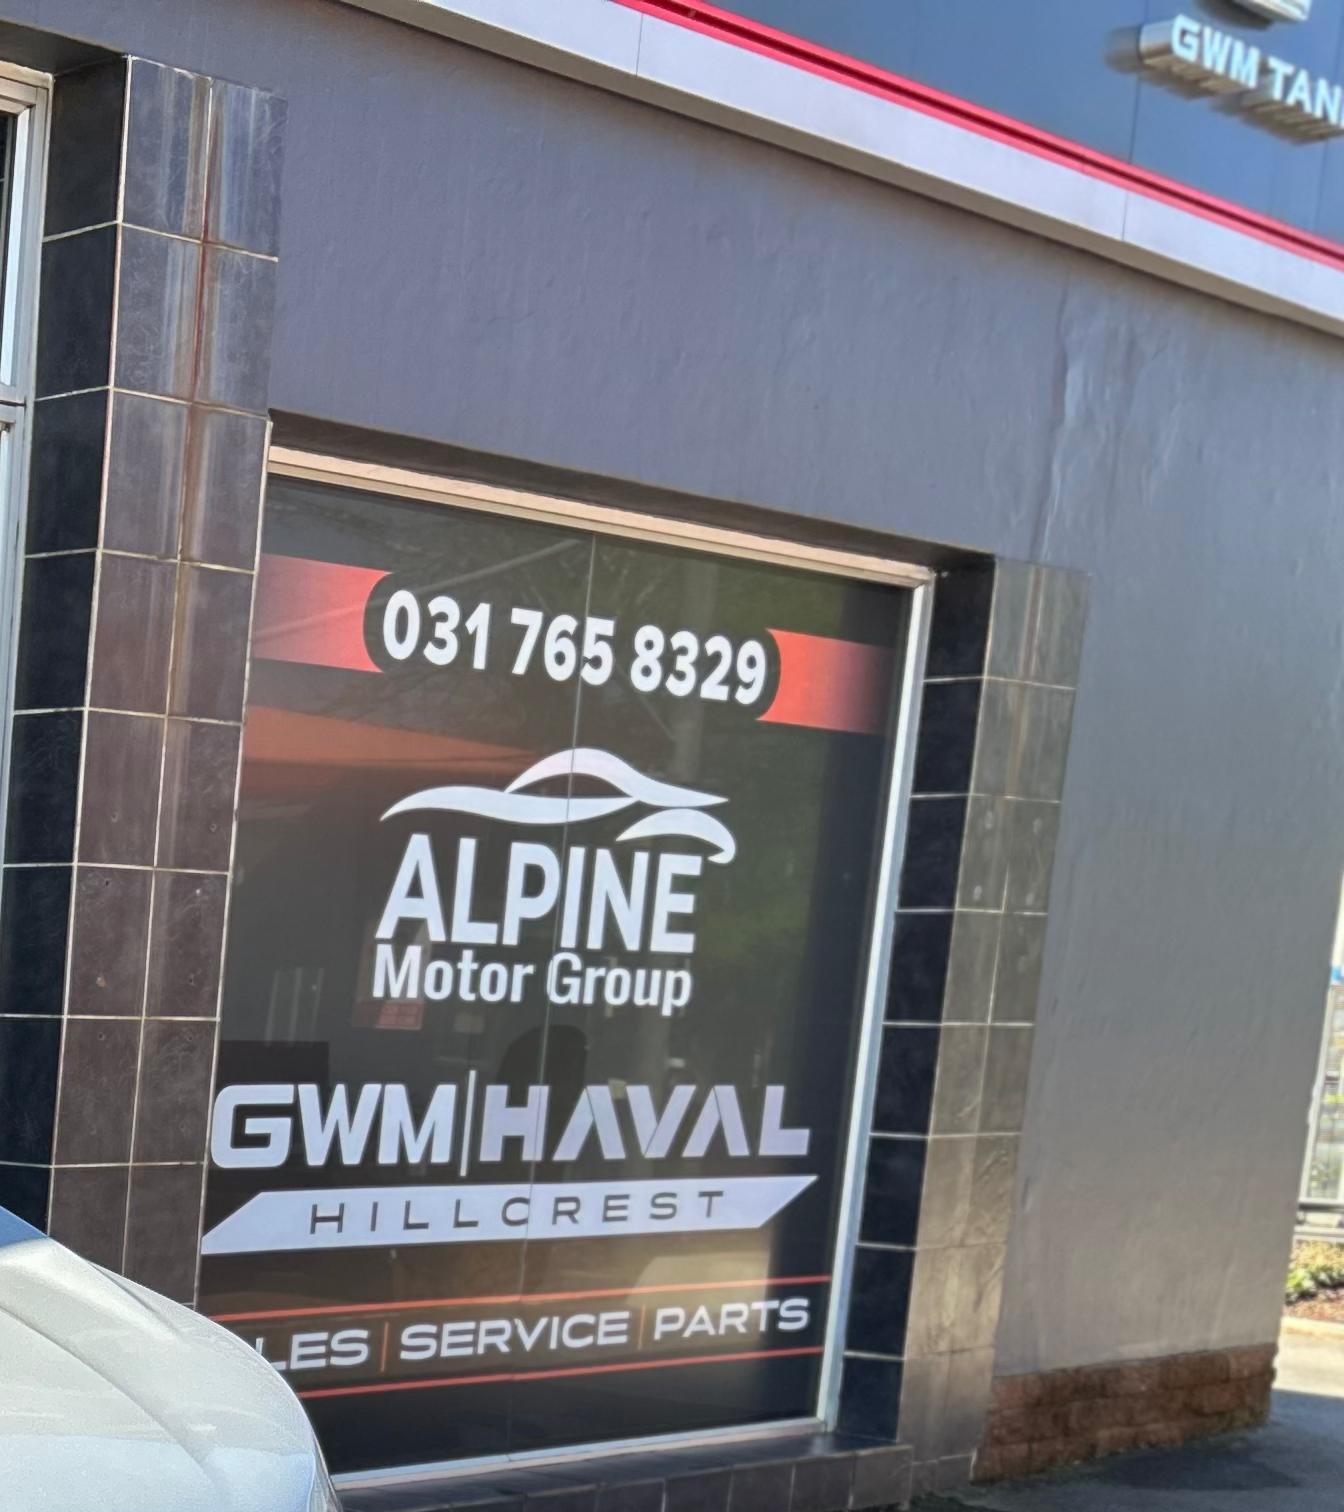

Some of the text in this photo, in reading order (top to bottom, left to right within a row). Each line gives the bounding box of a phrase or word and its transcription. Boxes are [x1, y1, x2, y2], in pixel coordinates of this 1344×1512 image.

[1171, 13, 1344, 129] GWM TAN
[383, 589, 767, 705] 031 765 8329
[375, 833, 703, 953] ALPINE
[372, 943, 693, 1017] Motor Group
[211, 1083, 810, 1168] GWM HAVAL
[309, 1190, 724, 1235] HILLCREST
[400, 1311, 630, 1360] SERVICE
[654, 1298, 810, 1340] PARTS
